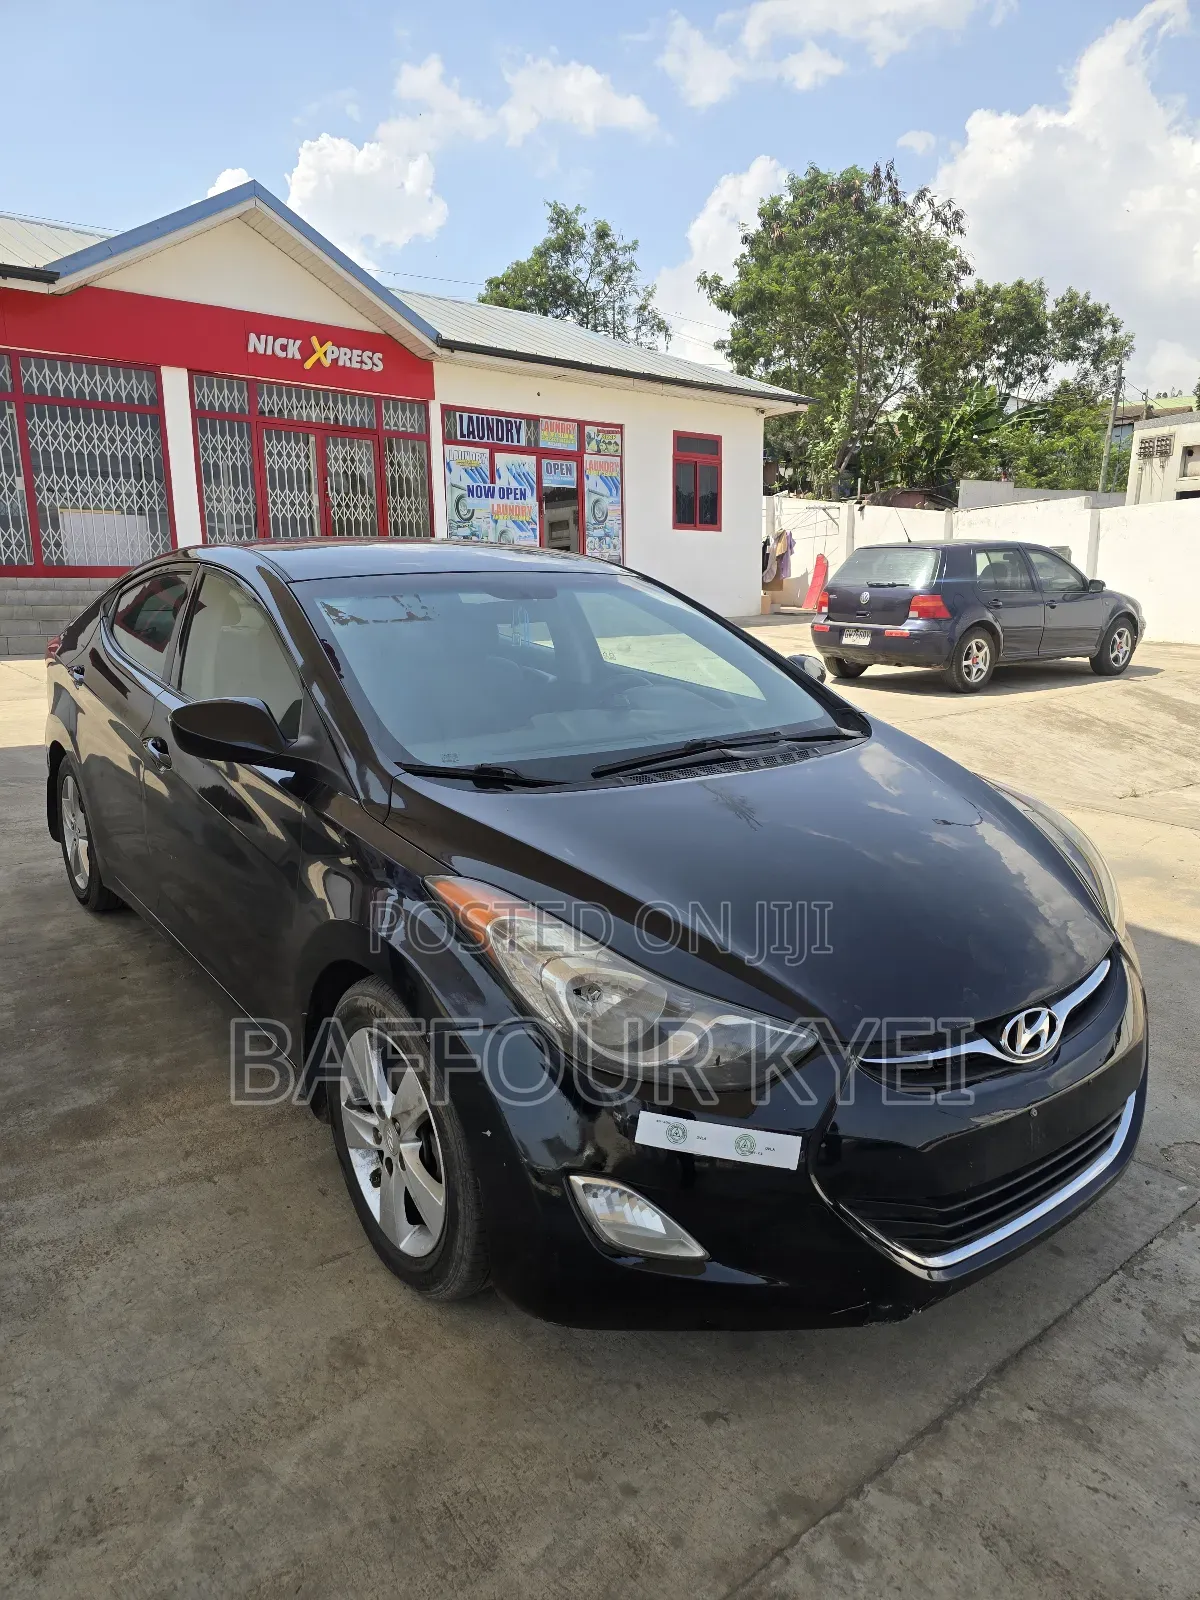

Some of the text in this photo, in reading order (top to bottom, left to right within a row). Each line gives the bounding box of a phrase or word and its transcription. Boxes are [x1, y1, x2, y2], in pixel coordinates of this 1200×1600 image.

[247, 332, 384, 372] NICK XPRESS
[458, 413, 523, 444] LAUNDRY
[540, 419, 576, 435] LAUNDRY
[545, 461, 573, 476] OPEN
[585, 459, 619, 473] LAUNDRY
[466, 484, 527, 501] NOW OPEN
[491, 503, 532, 517] LAUNDRY
